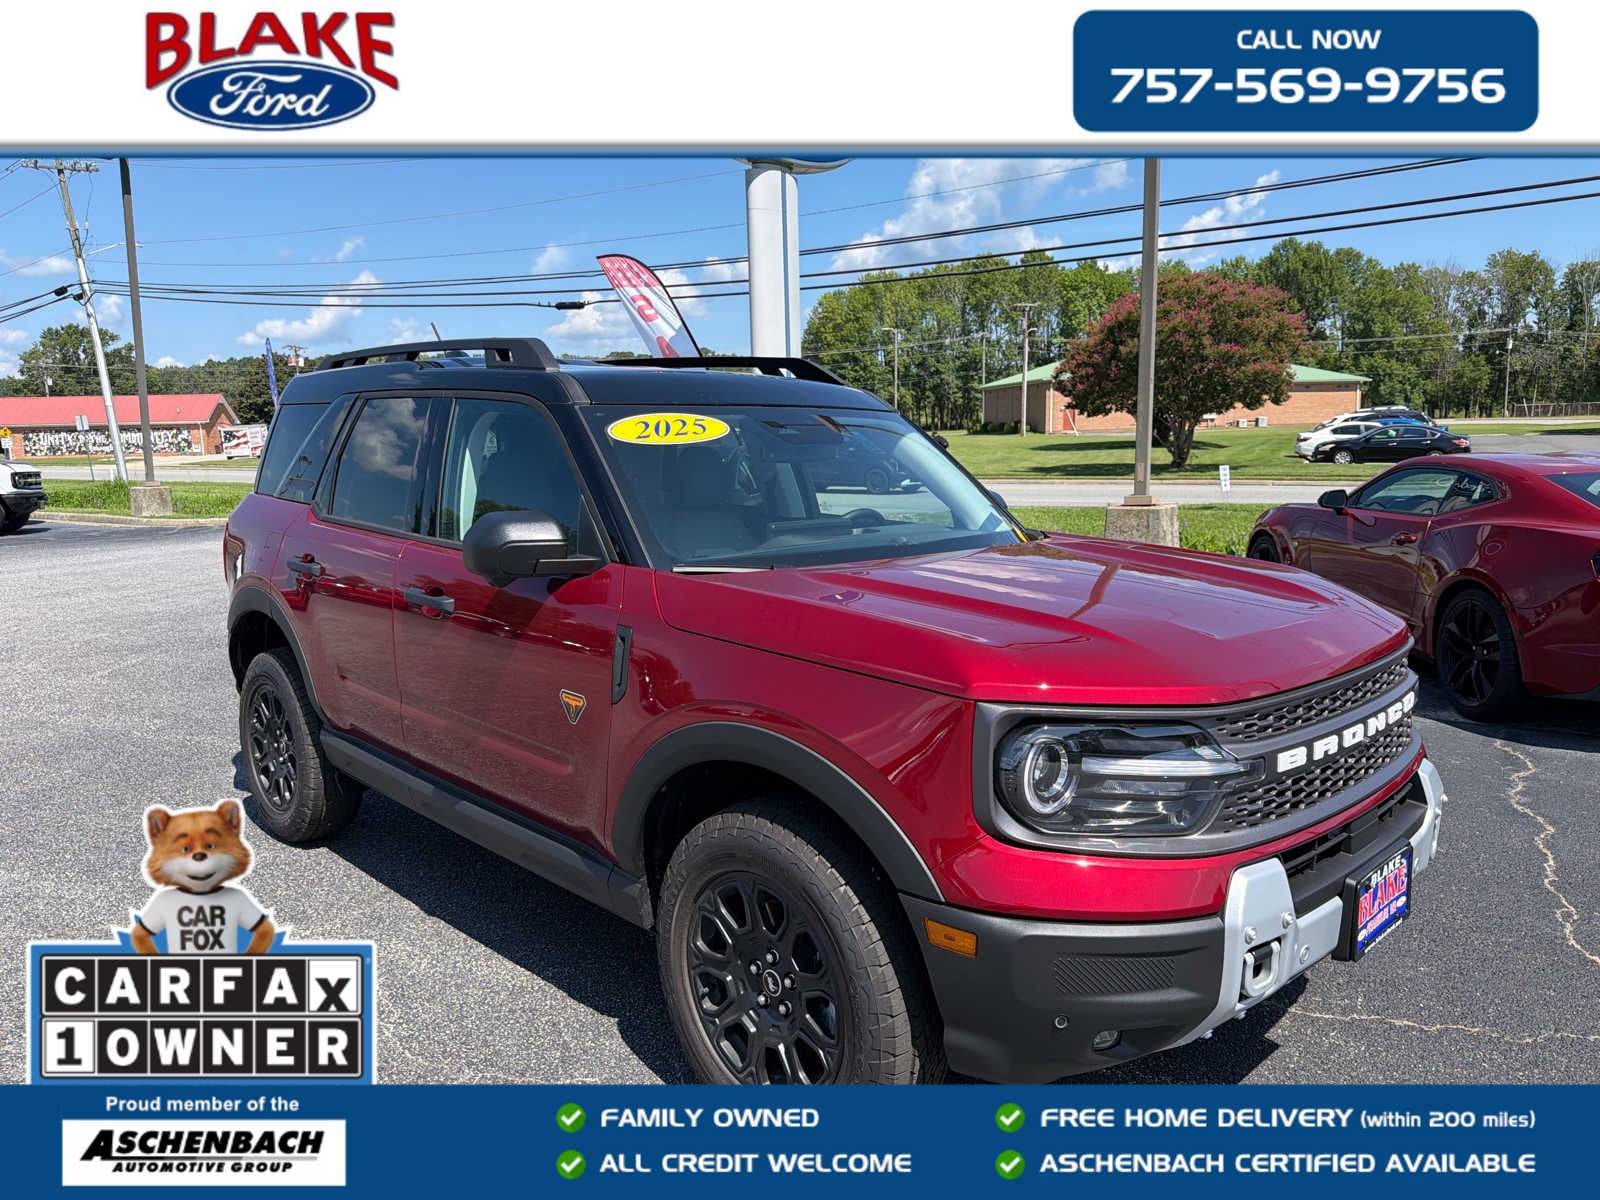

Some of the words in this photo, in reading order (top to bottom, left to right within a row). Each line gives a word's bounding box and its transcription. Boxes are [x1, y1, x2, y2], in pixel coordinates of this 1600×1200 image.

[634, 417, 708, 440] 2025
[1277, 690, 1415, 774] BRONCO
[1371, 854, 1402, 888] BLAKE
[1358, 865, 1408, 929] BLAKE
